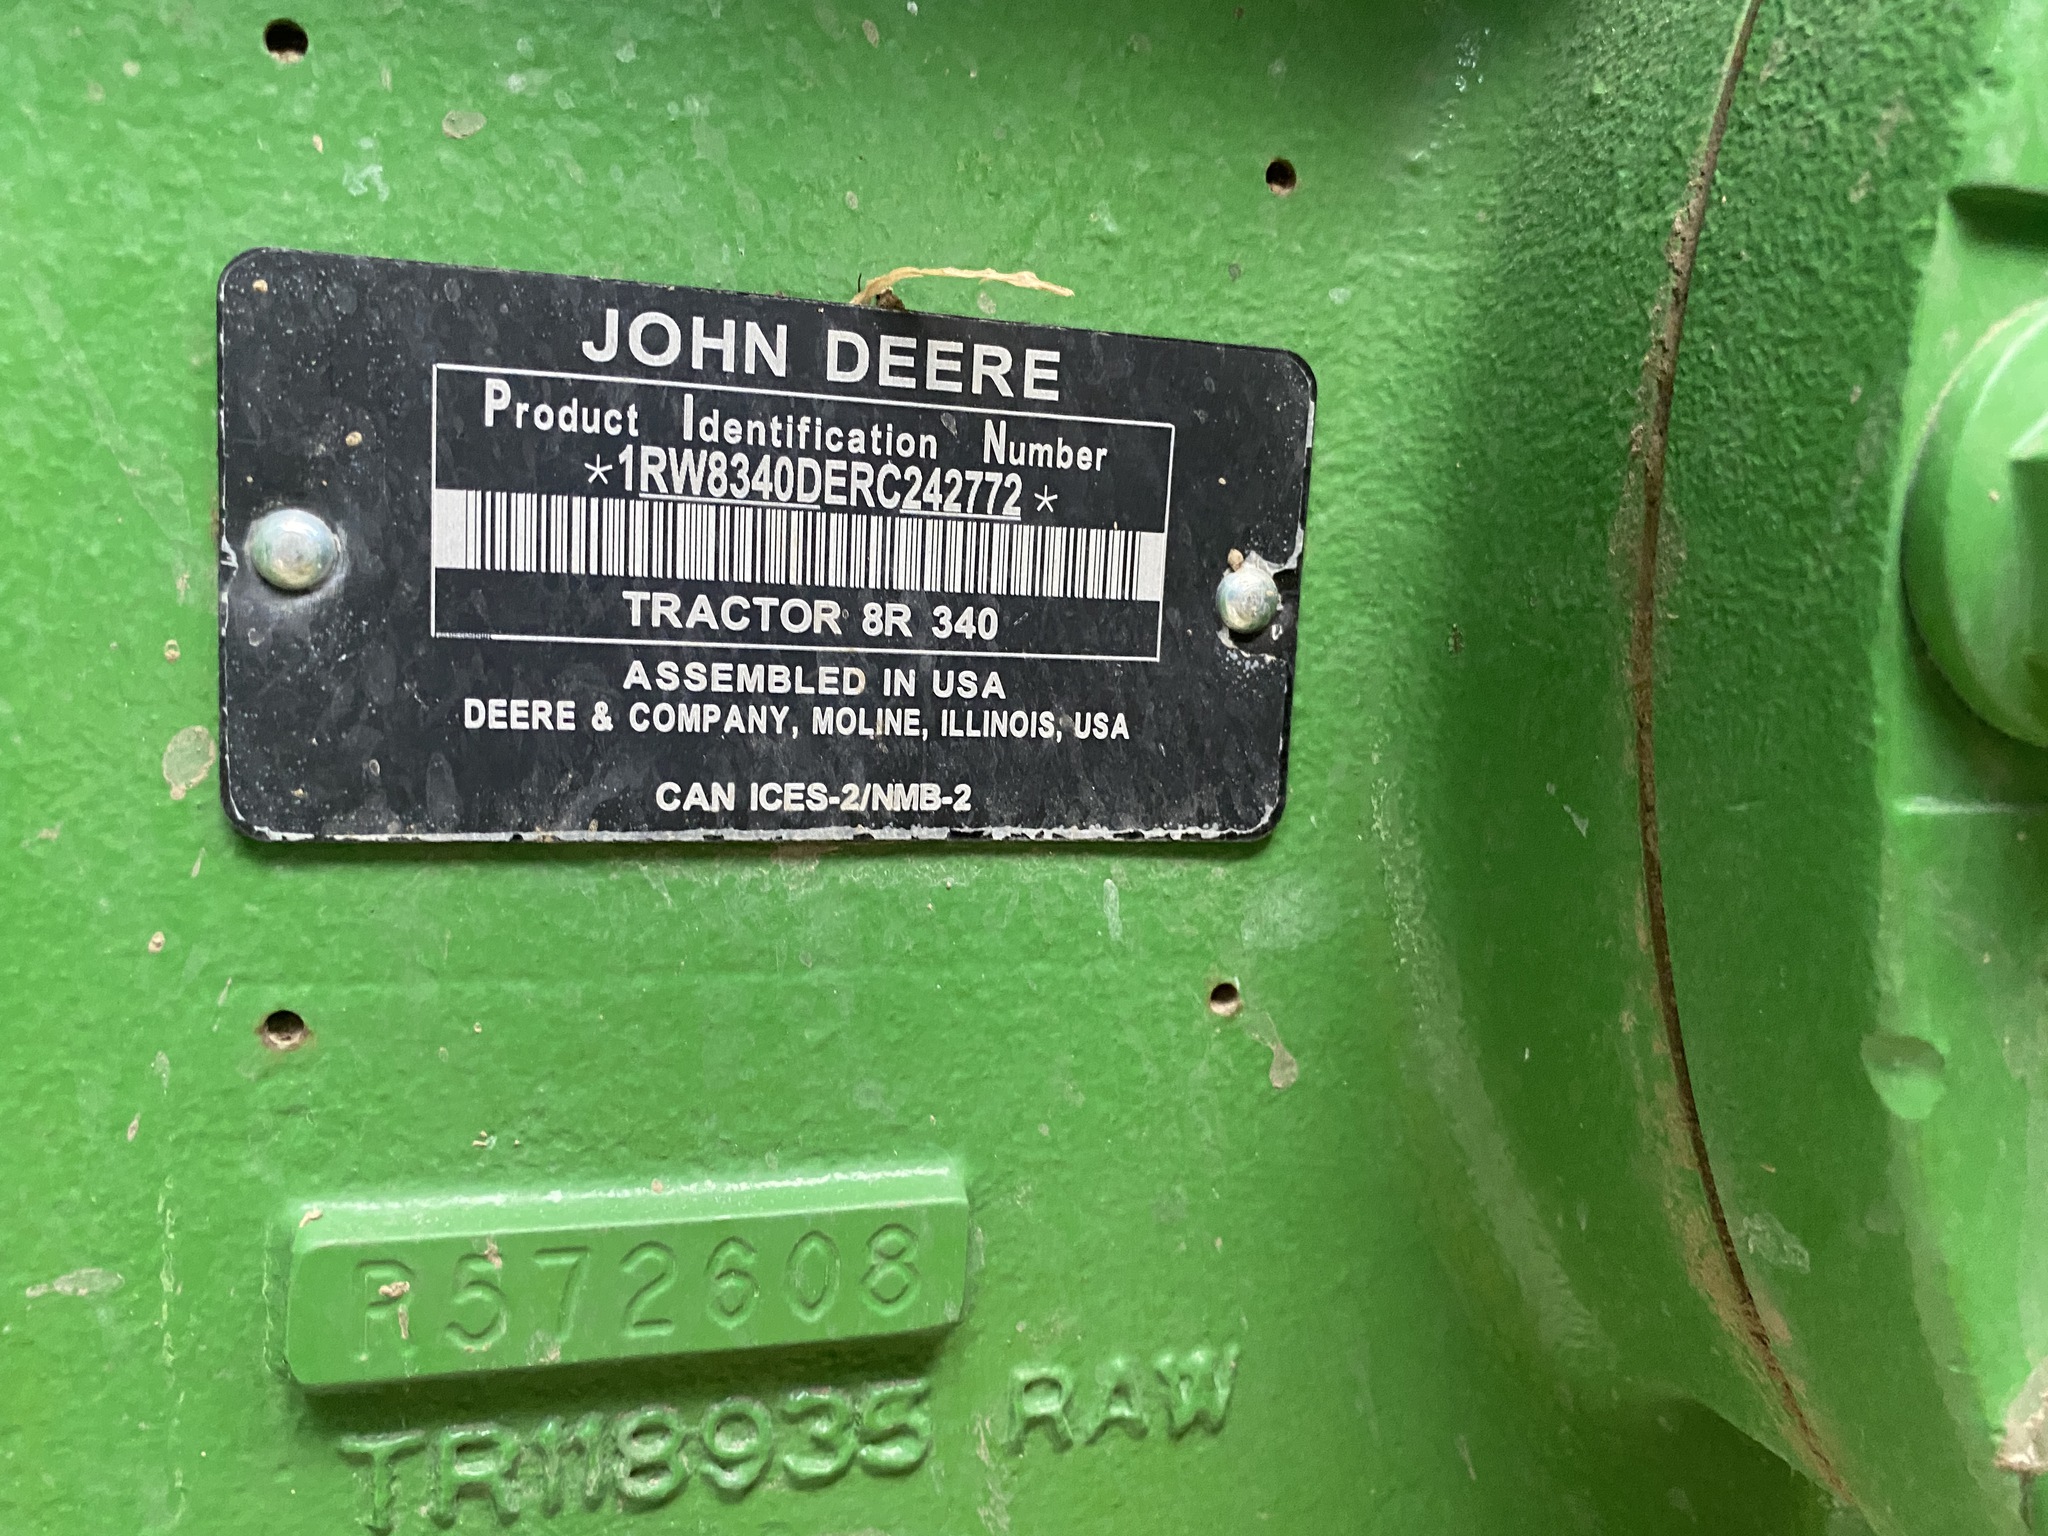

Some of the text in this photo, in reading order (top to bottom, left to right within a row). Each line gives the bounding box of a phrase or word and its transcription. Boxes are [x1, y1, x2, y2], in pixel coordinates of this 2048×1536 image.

[582, 308, 1061, 402] JOHN DEERE
[484, 378, 1108, 472] Product Identification Number
[622, 590, 999, 640] TRACTOR 8R 340
[623, 660, 1006, 699] ASSEMBLED IN USA
[464, 698, 1130, 744] DEERE & COMPANY, MOLINE, ILLINOIS, USA
[655, 781, 972, 812] CAN ICES-2/NMB-2
[353, 1222, 922, 1362] R572608
[1002, 1340, 1242, 1456] RAW
